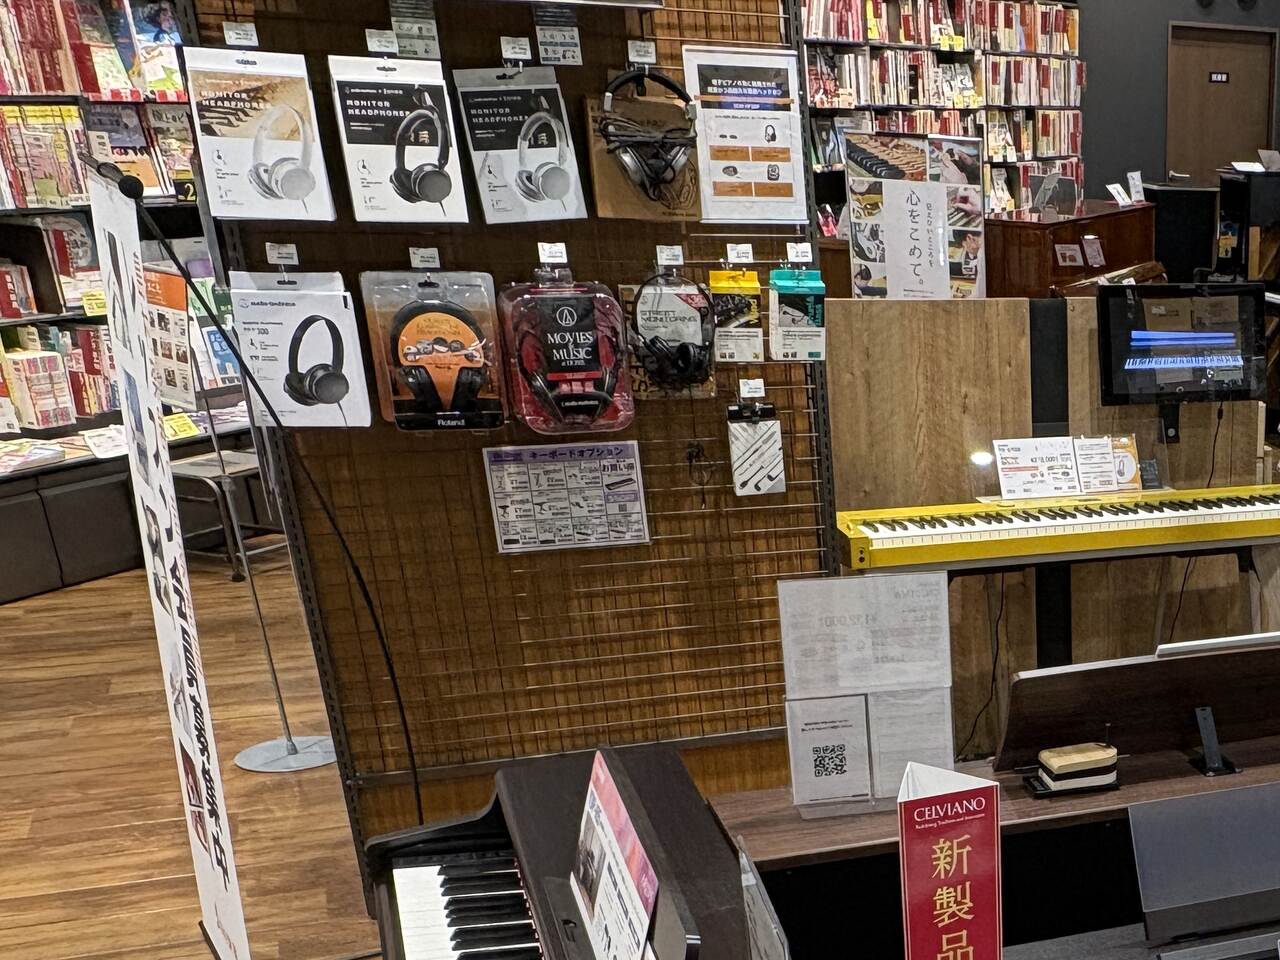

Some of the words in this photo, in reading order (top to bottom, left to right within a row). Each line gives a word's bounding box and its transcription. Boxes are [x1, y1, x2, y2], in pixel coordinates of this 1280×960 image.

[201, 90, 249, 99] MONITOR
[346, 99, 390, 107] MONITOR
[184, 183, 197, 200] 2
[906, 190, 924, 285] 心をこめて。
[547, 331, 594, 344] MOVIES
[553, 348, 592, 360] MUSIC
[438, 419, 465, 427] Roland
[530, 447, 624, 459] キーボードオプション
[914, 797, 985, 822] CELVIANO
